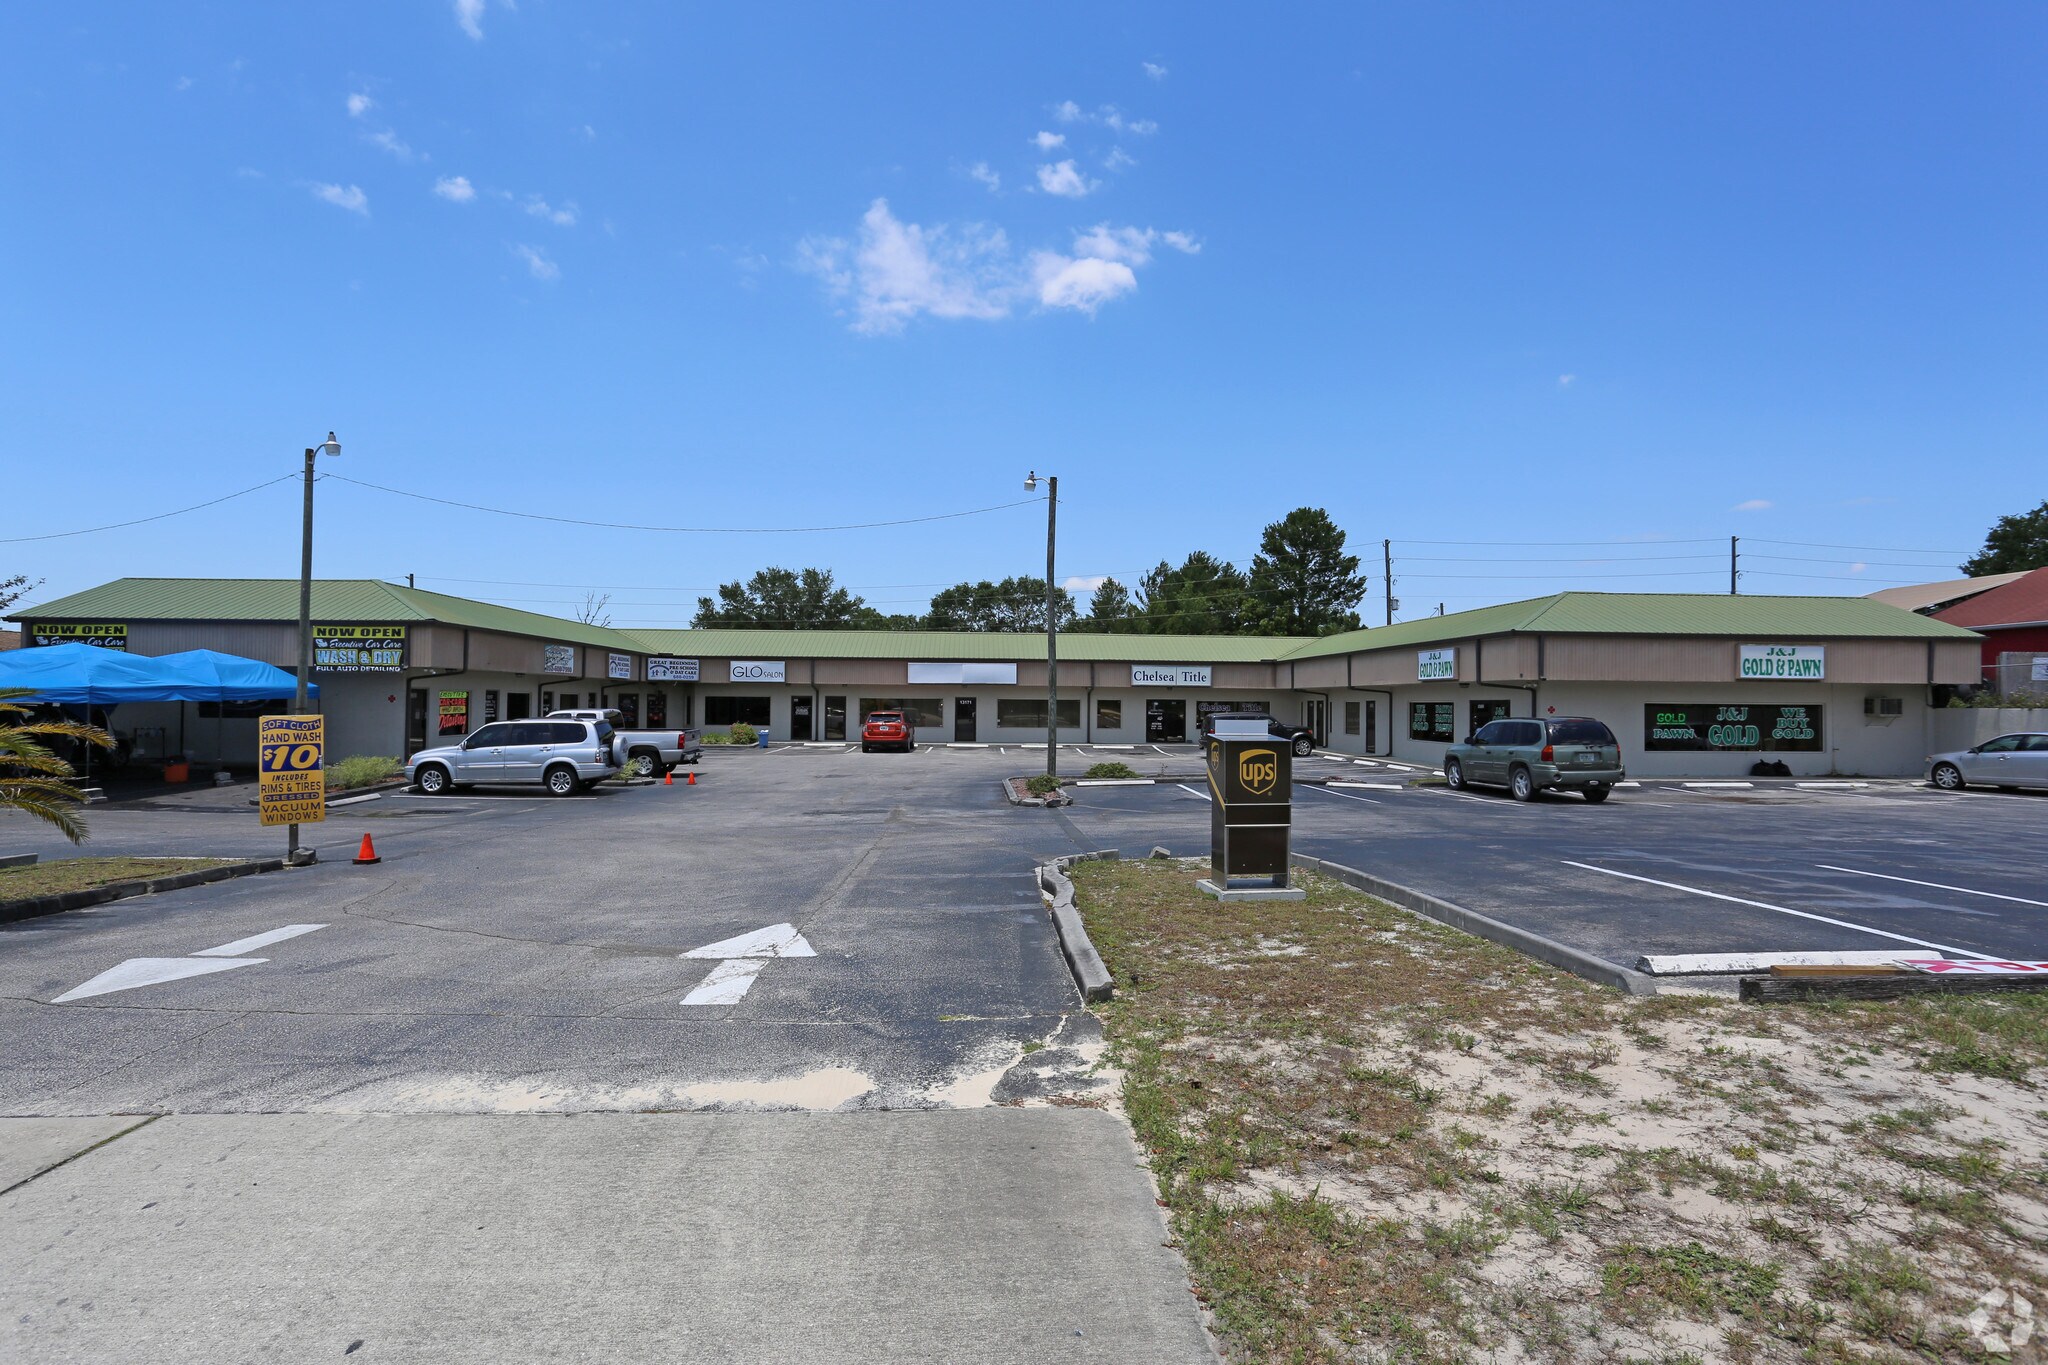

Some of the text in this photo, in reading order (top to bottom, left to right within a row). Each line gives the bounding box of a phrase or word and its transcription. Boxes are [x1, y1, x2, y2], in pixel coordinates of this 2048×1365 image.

[37, 625, 124, 634] NOW OPEN
[316, 628, 402, 637] NOW OPEN
[88, 636, 102, 646] Car
[105, 636, 124, 646] Care
[329, 638, 402, 648] Executive Car Care
[316, 650, 402, 664] WASH & DRY
[1428, 652, 1442, 660] J&J
[1766, 648, 1796, 656] J&J
[1420, 662, 1432, 678] GOLD
[1438, 661, 1453, 677] PAWN
[1742, 658, 1822, 677] GOLD & PAWN
[1134, 670, 1207, 682] Chelsea Title
[1198, 704, 1262, 712] Chelsea Title
[1716, 706, 1748, 721] J&J
[1780, 707, 1806, 718] WE
[1656, 713, 1686, 722] GOLD
[1776, 718, 1810, 728] BUY
[262, 720, 321, 731] SOFT CLOTH
[1412, 722, 1429, 731] GOLD
[262, 732, 321, 744] HAND WASH
[1653, 728, 1694, 739] PAWN
[1708, 724, 1760, 746] GOLD
[1772, 728, 1814, 740] GOLD
[264, 745, 319, 770] $10
[272, 774, 309, 782] INCLUDES
[1242, 763, 1274, 788] ups
[261, 782, 322, 794] RIMS & TIRES
[264, 793, 320, 802] DRESSED
[262, 802, 321, 813] VACUUM
[266, 812, 318, 822] WINDOWS
